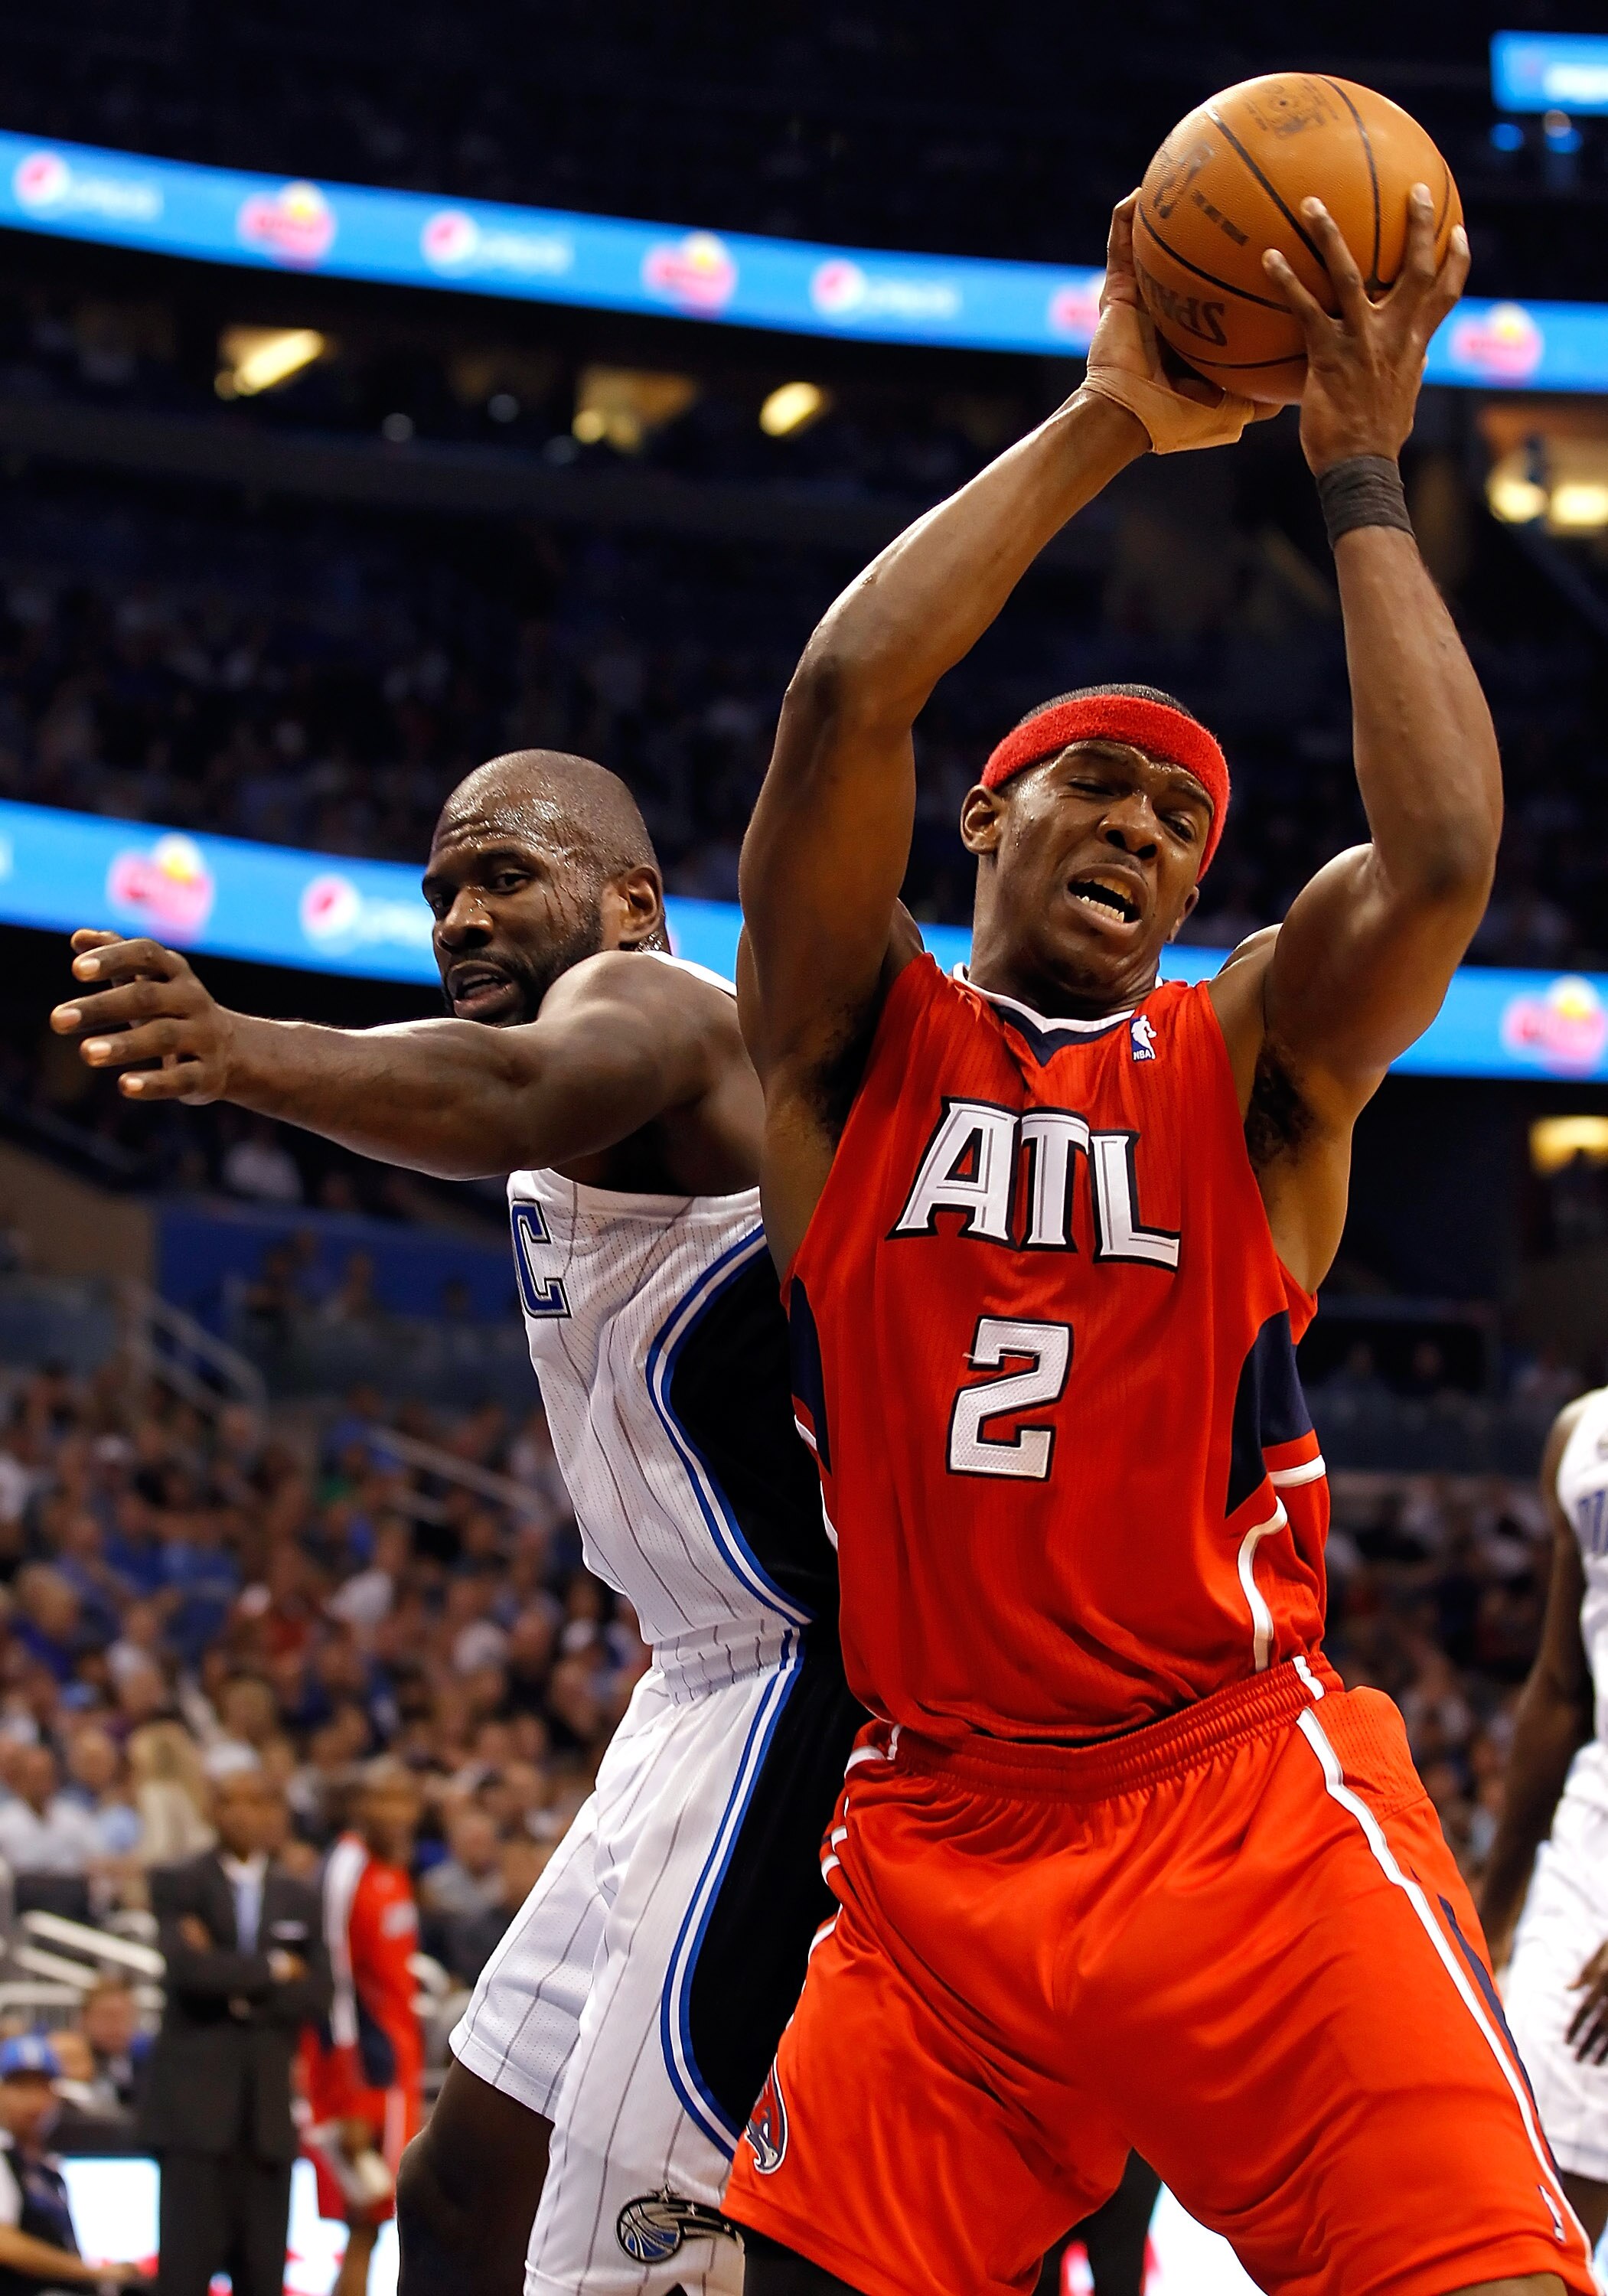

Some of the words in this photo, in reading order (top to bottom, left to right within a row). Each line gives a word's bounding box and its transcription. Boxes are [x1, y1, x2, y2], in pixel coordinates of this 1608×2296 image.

[1133, 1049, 1152, 1061] NBA
[886, 1096, 1181, 1273] ATL
[510, 1198, 572, 1319] C
[947, 1316, 1073, 1481] 2
